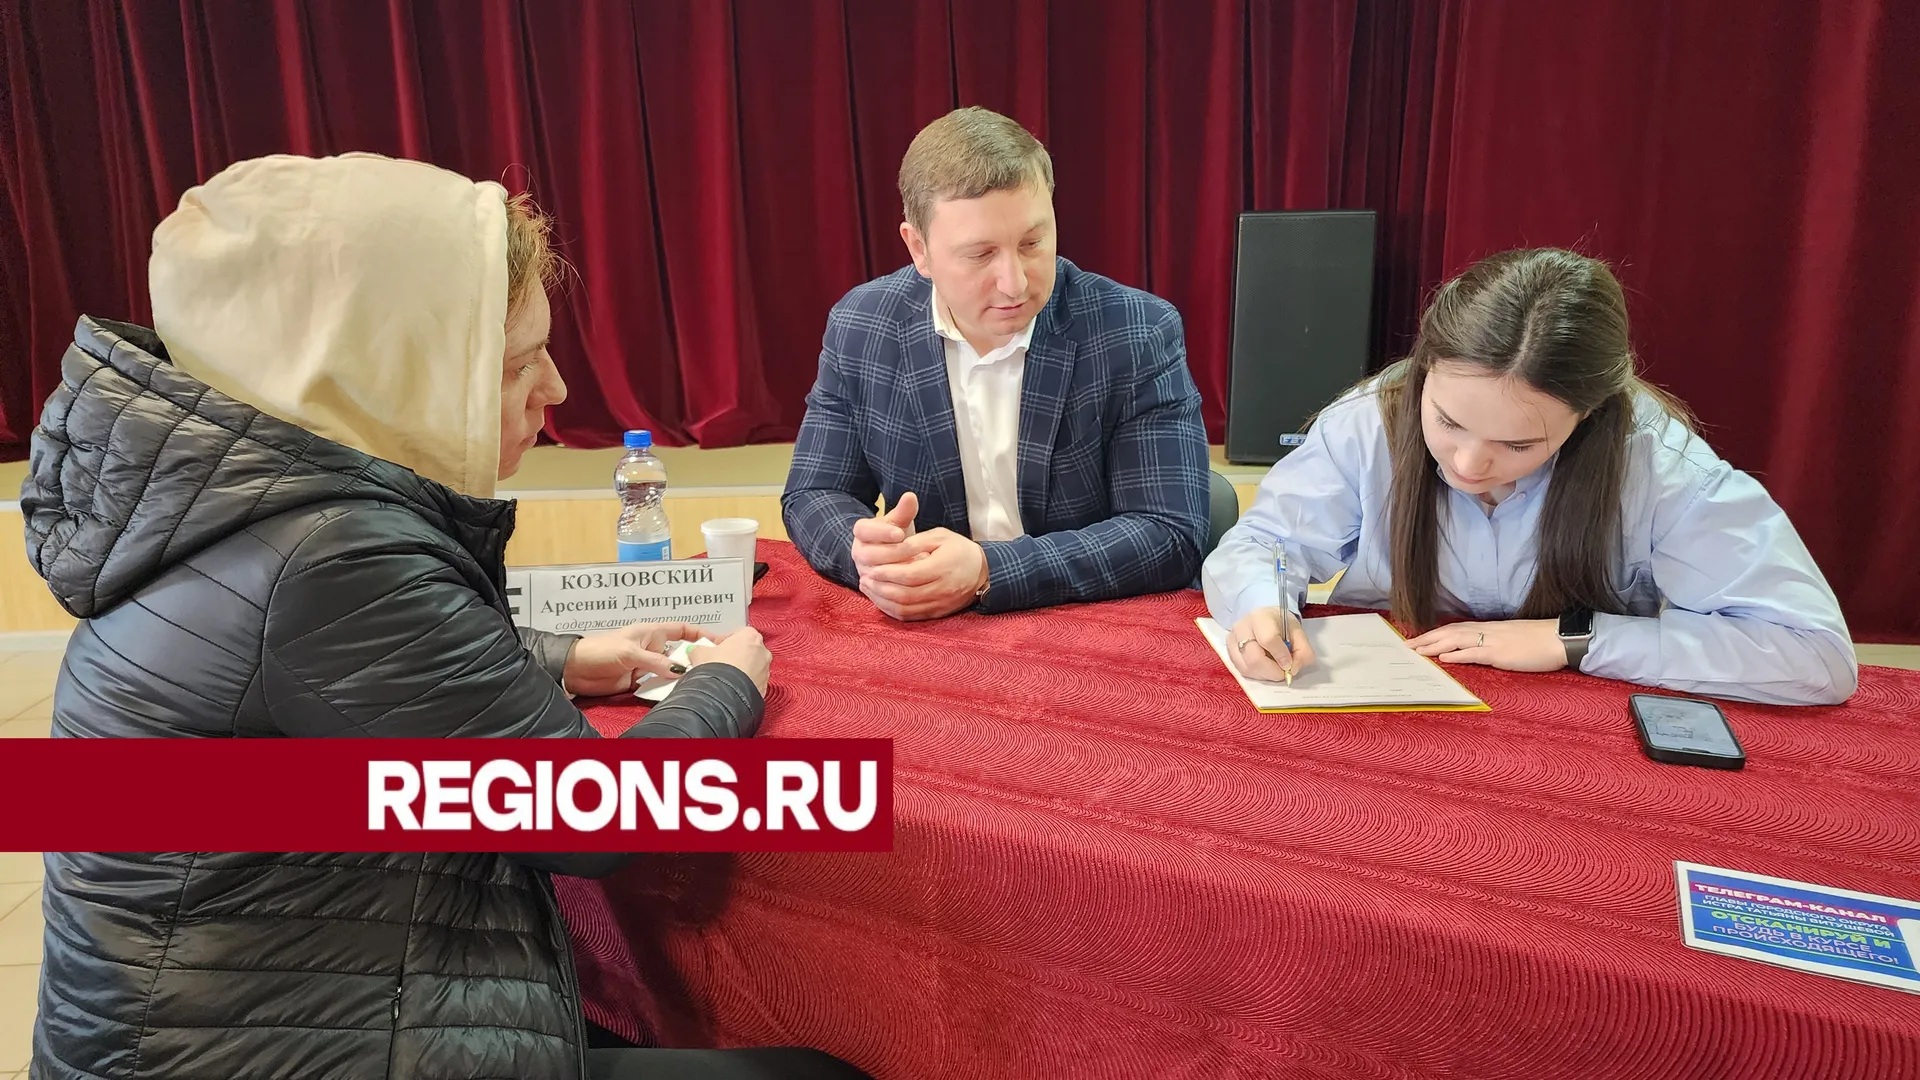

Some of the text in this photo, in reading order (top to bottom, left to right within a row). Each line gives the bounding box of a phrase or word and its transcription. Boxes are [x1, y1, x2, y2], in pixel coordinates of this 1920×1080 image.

[561, 565, 714, 590] КОЗЛОВСКИЙ
[541, 593, 734, 616] Арсений Дмитриевич
[555, 618, 636, 632] содержание
[1694, 884, 1887, 923] ТЕЛЕГРАМ-КАНАЛ
[1702, 899, 1895, 938] ИСТРА ТАТЬЯНЫ ВИТУШЕВОЙ
[1704, 894, 1890, 931] ГЛАВЫ ГОРОДСКОГО ОКРУГА
[1711, 910, 1892, 950] ОТСКАНИРУЙ И
[1712, 925, 1900, 965] ПРОИСХОДЯЩЕГО!
[1734, 922, 1872, 953] БУДЬ В КУРСЕ
